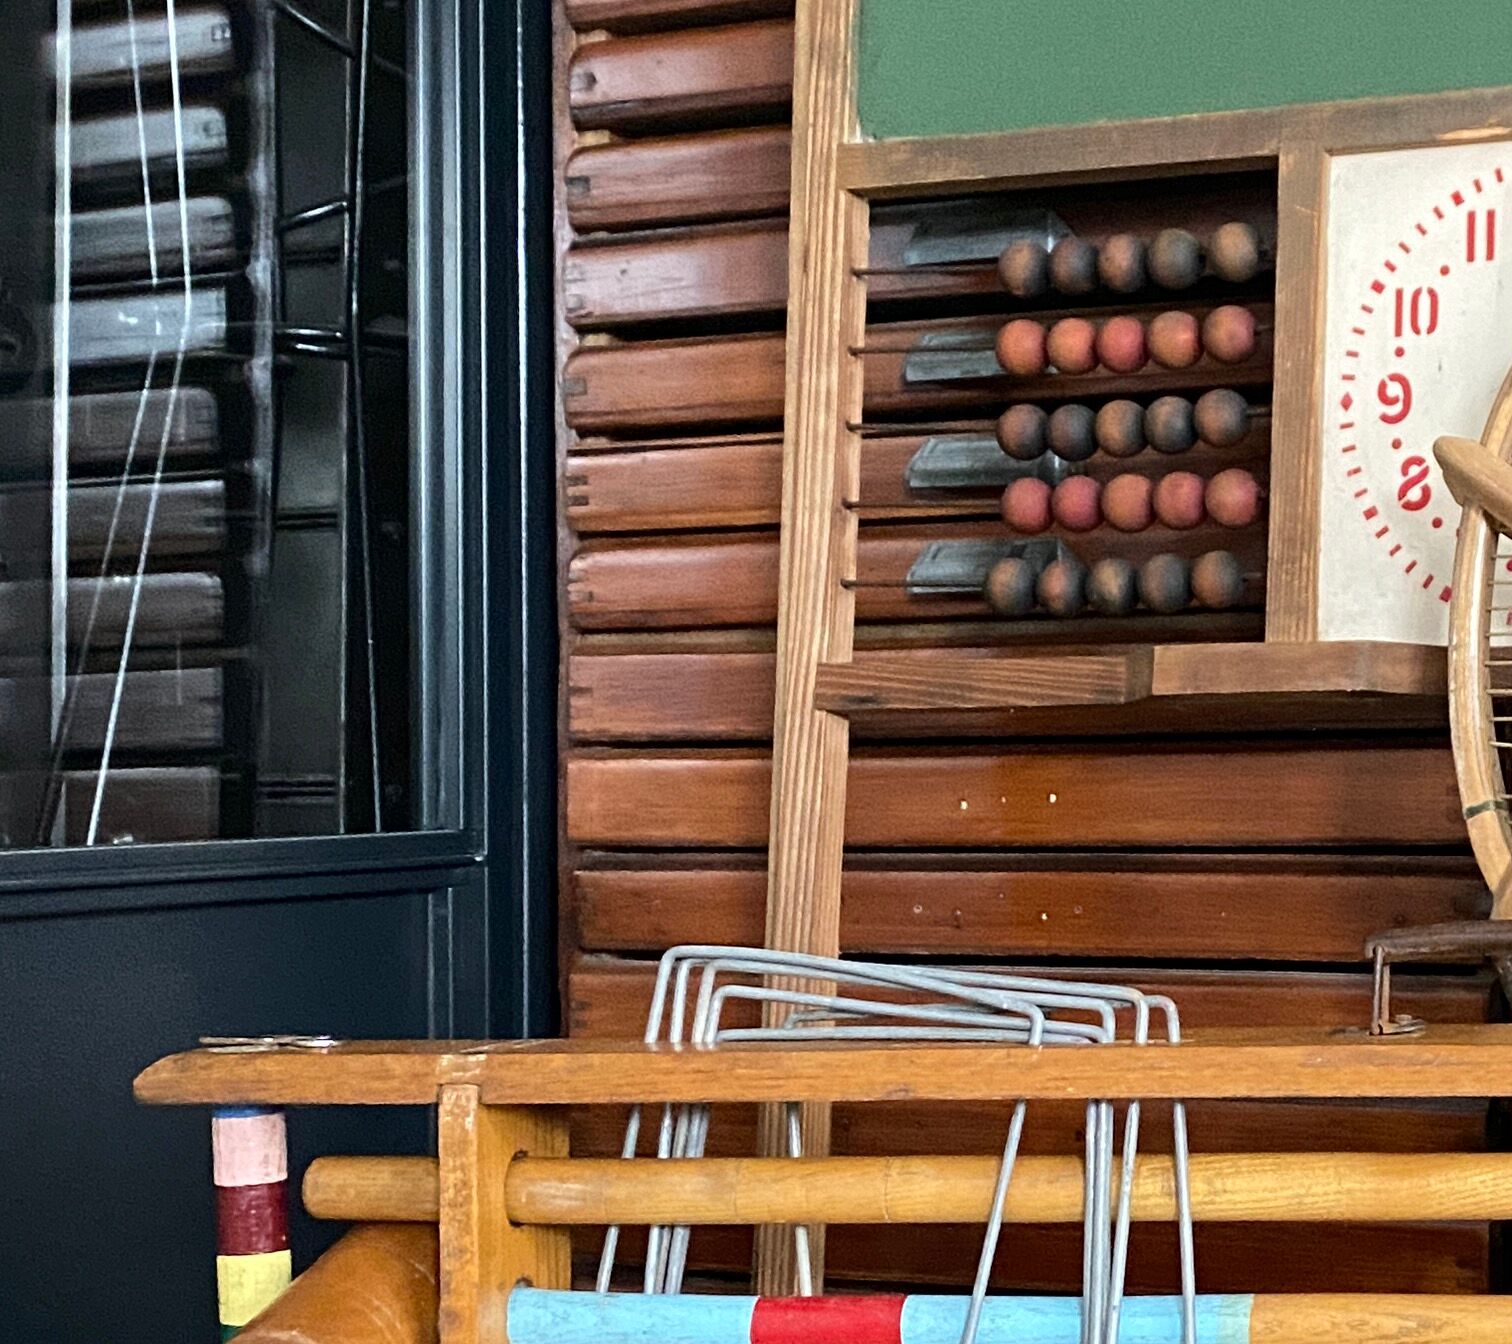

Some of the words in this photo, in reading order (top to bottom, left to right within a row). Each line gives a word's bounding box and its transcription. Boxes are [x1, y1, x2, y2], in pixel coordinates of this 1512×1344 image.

[1466, 209, 1496, 263] 11
[1395, 286, 1439, 338] 10
[1376, 372, 1413, 425] 9
[1398, 455, 1433, 512] 8
